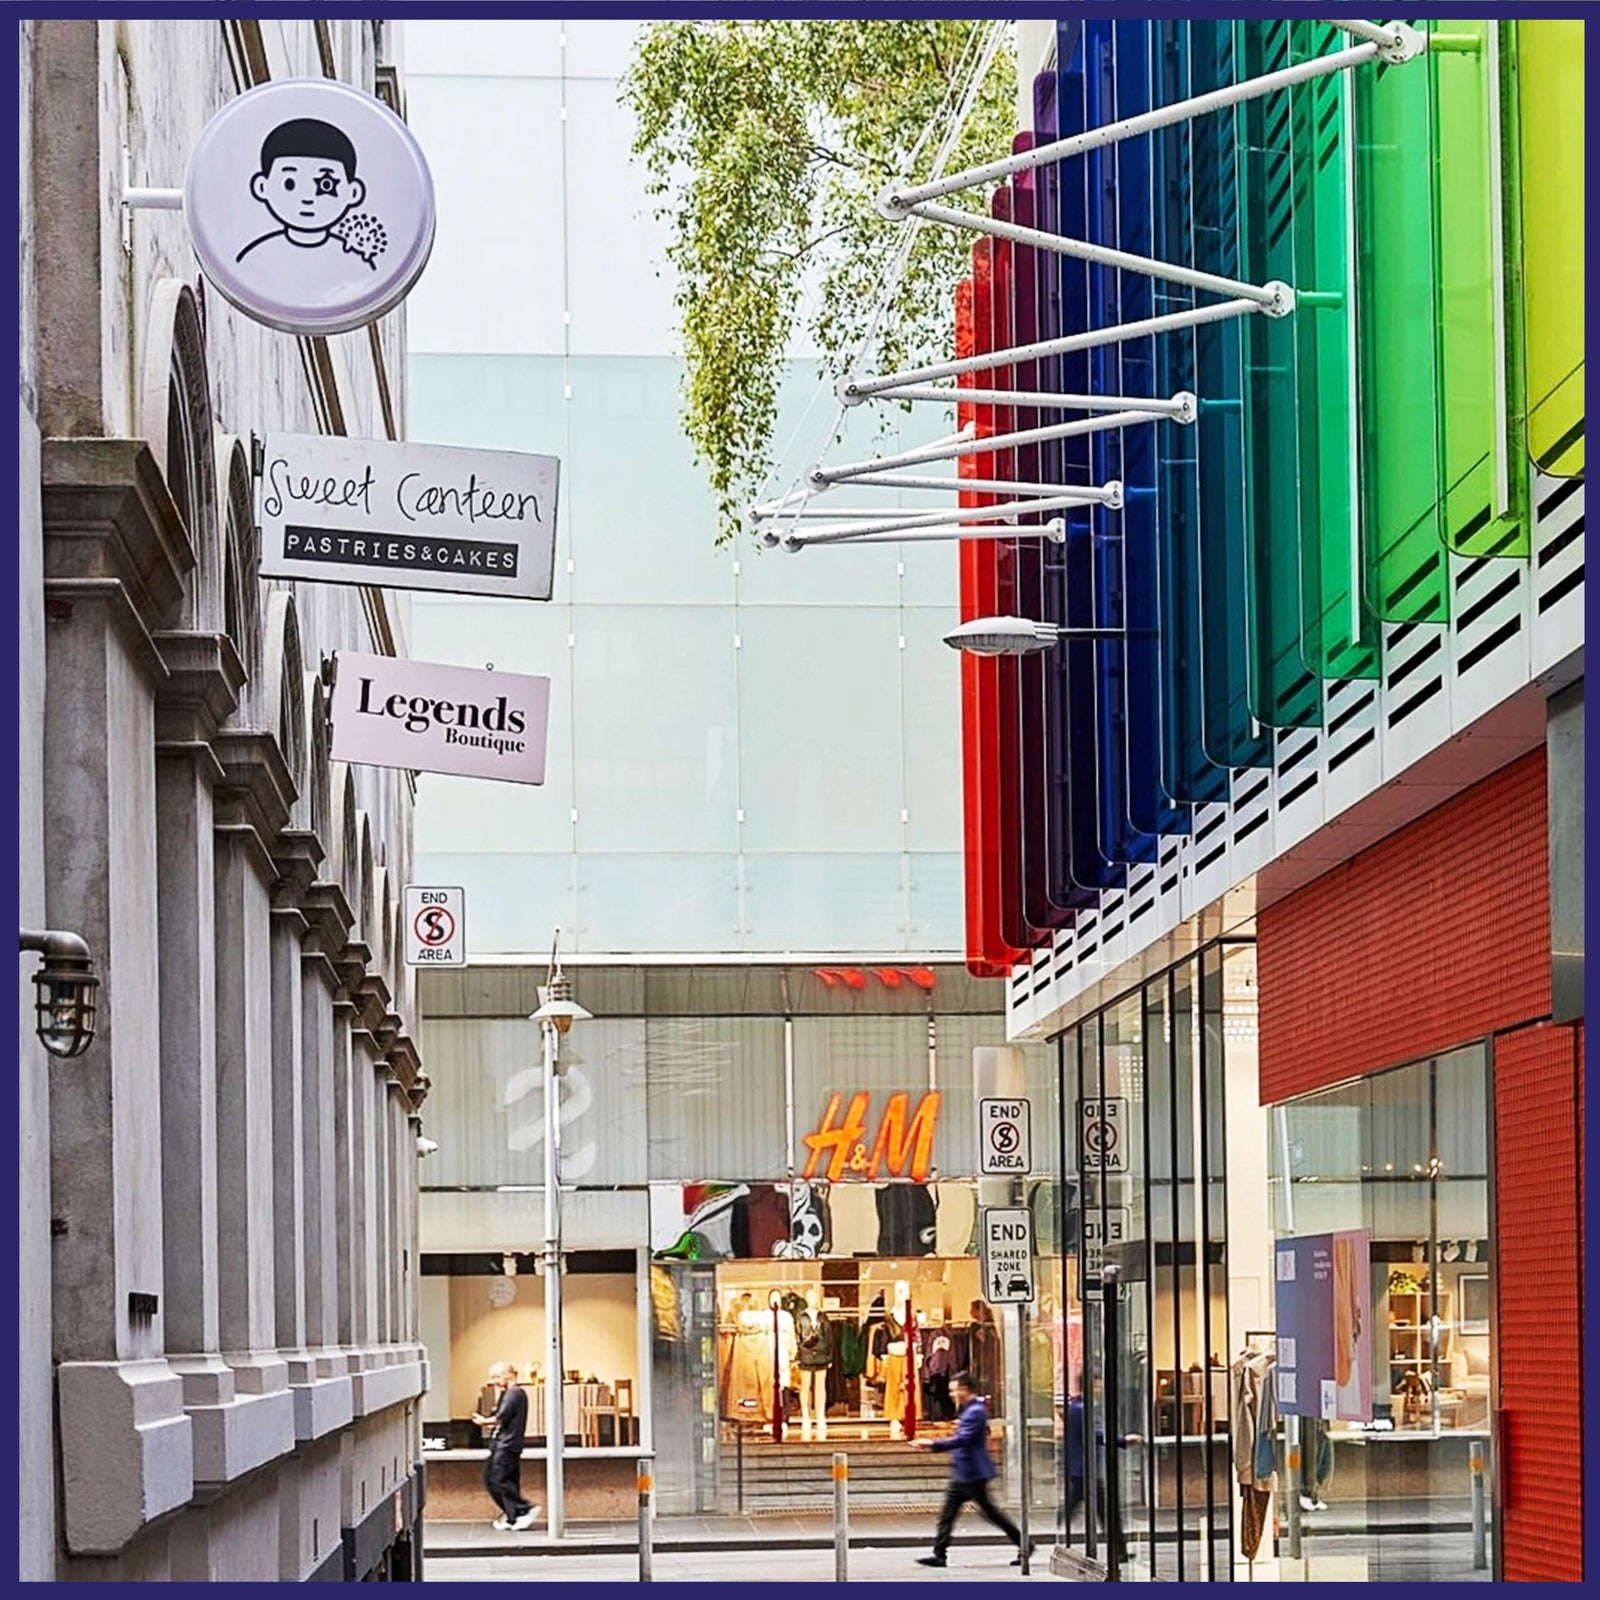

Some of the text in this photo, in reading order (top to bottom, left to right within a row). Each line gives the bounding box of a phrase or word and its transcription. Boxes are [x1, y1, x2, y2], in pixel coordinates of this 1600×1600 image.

[264, 459, 542, 523] Sweet Canteen
[287, 534, 515, 569] PASTRIES&CAKES
[356, 677, 526, 734] Legends
[445, 727, 526, 755] Boutique
[421, 892, 448, 904] END
[418, 948, 452, 960] AREA
[990, 1105, 1021, 1118] END
[803, 1090, 942, 1182] H&M
[989, 1155, 1024, 1168] AREA
[991, 1224, 1027, 1241] END
[990, 1250, 1028, 1260] SHARED
[997, 1261, 1022, 1272] ZONE
